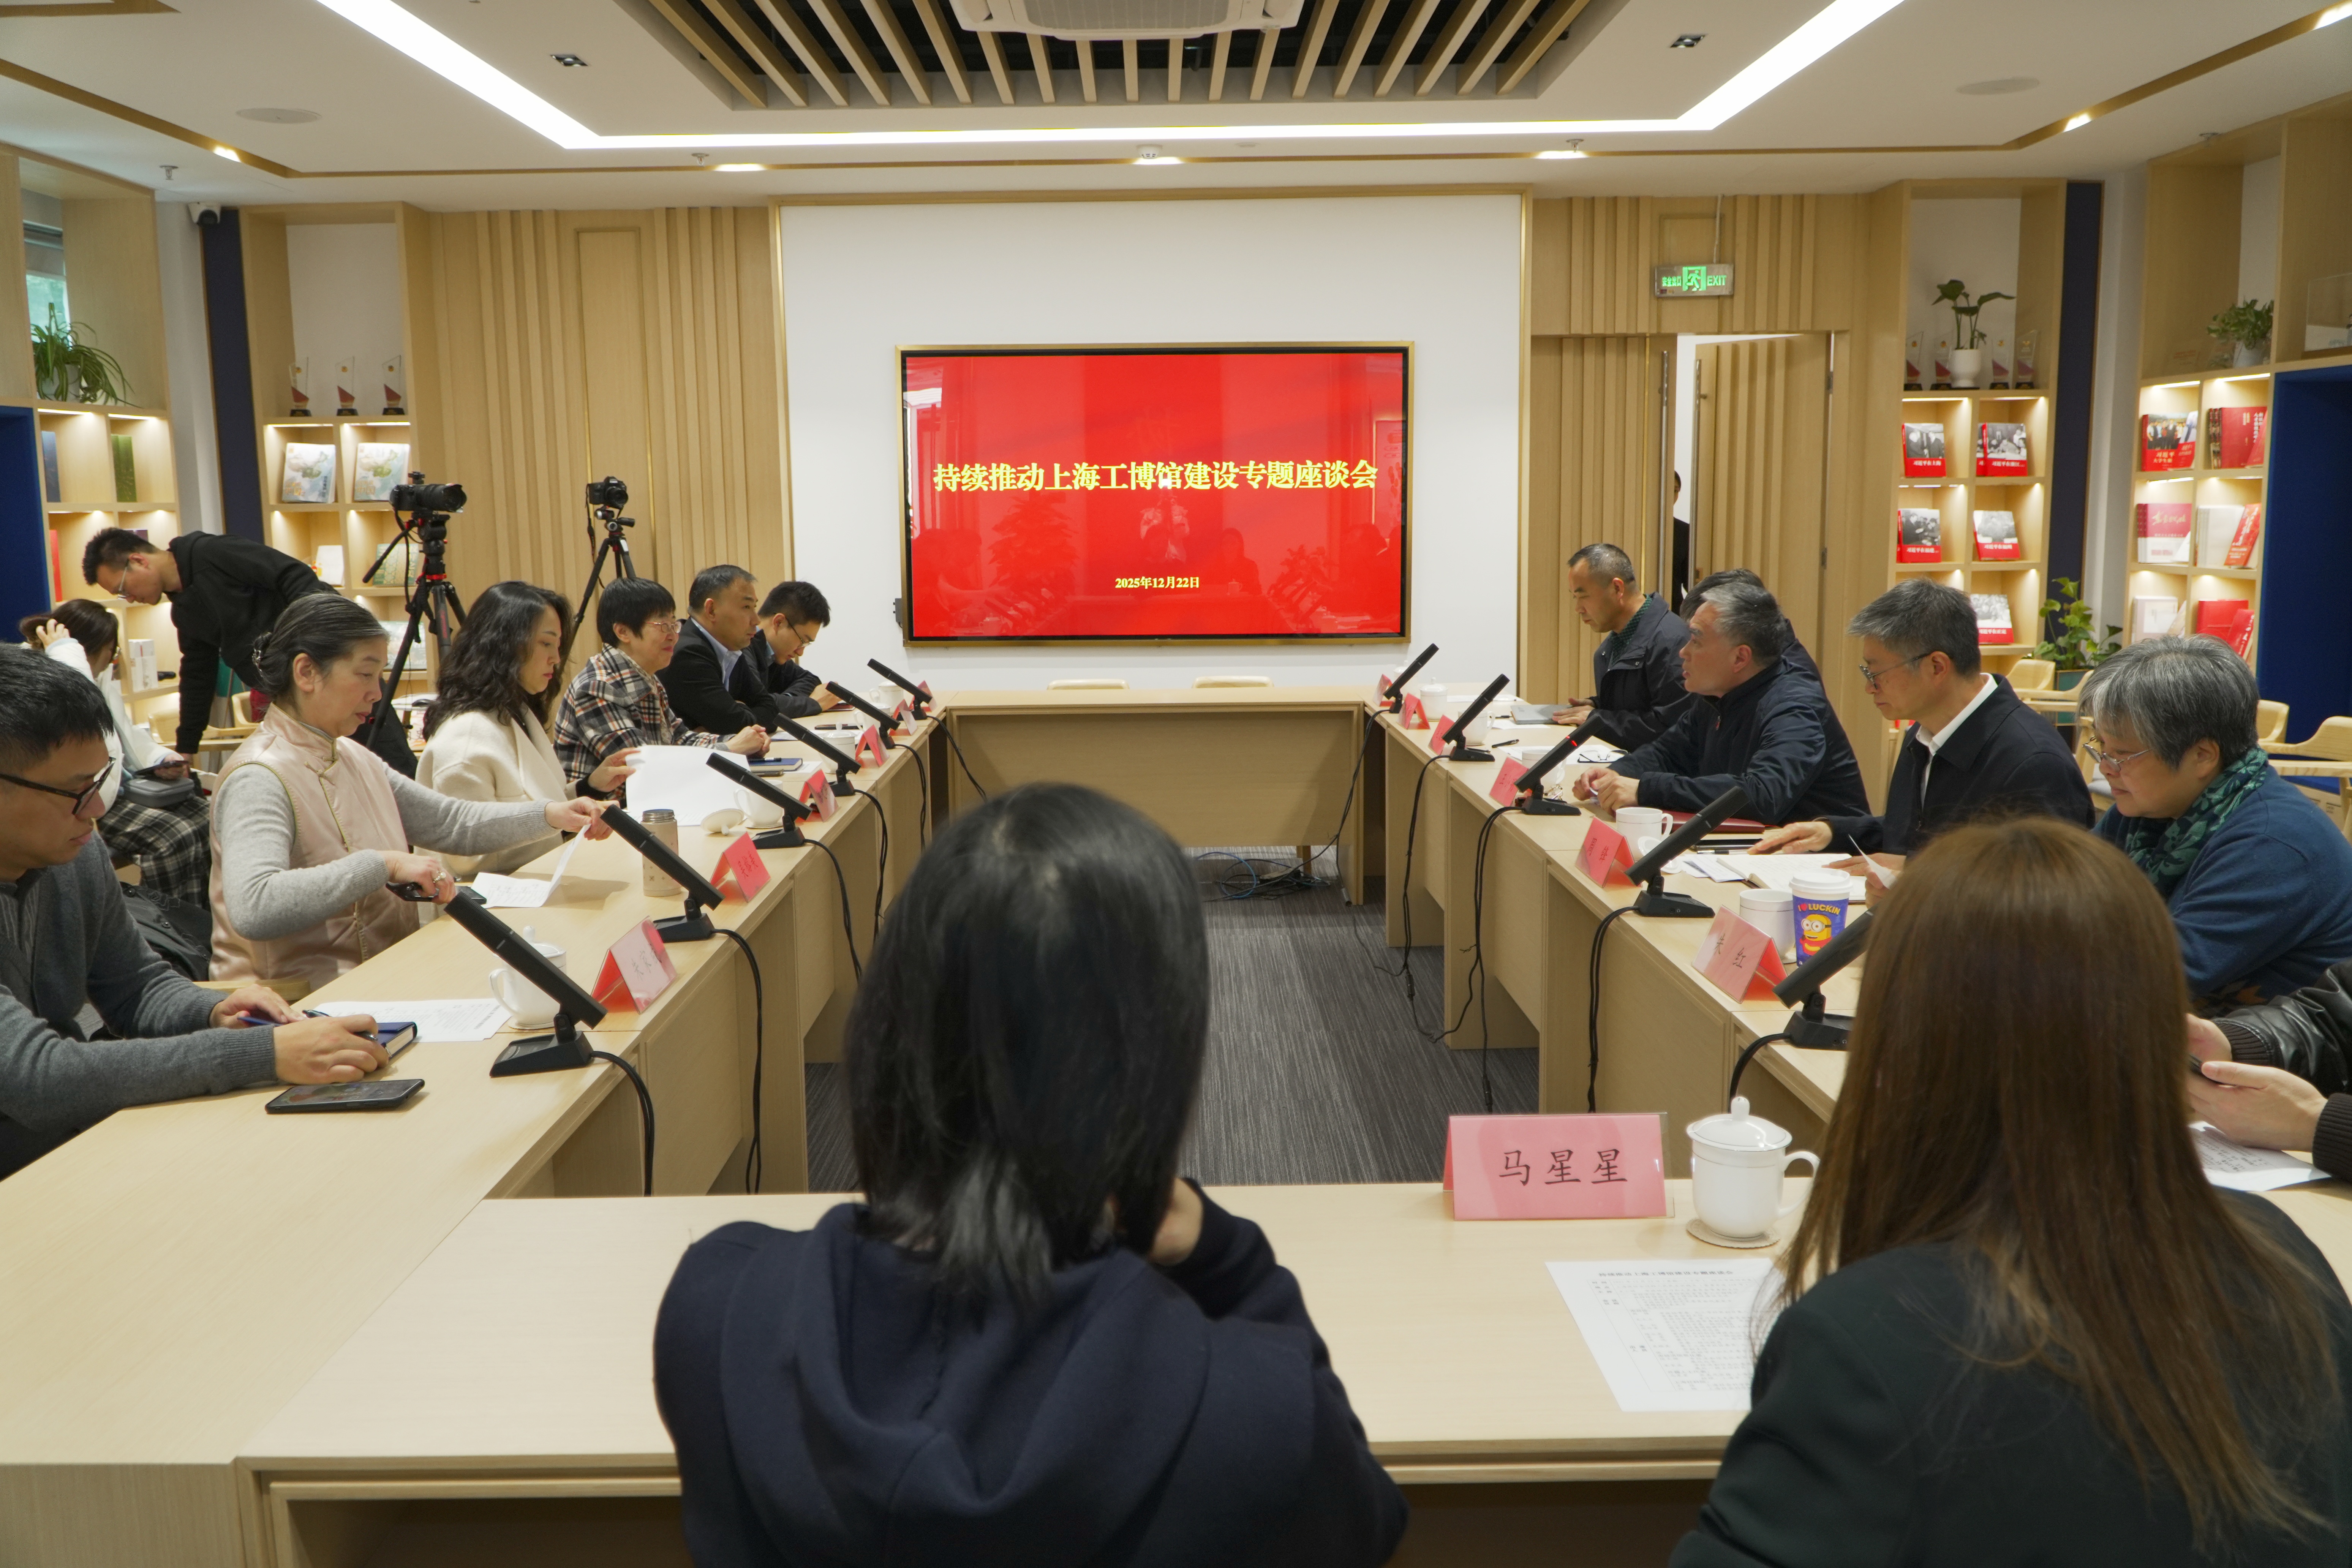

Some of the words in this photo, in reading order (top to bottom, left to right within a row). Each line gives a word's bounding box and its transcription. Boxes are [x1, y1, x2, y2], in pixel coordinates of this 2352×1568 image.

[1662, 276, 1682, 286] 安全出口
[1707, 275, 1726, 286] EXIT
[933, 460, 1378, 492] 持续推动上海工博馆建设专题座谈会
[1115, 576, 1199, 589] 2025年12月22日
[1808, 904, 1840, 915] LUCKIN
[1713, 933, 1747, 969] 朱红
[1499, 1149, 1628, 1186] 马星星
